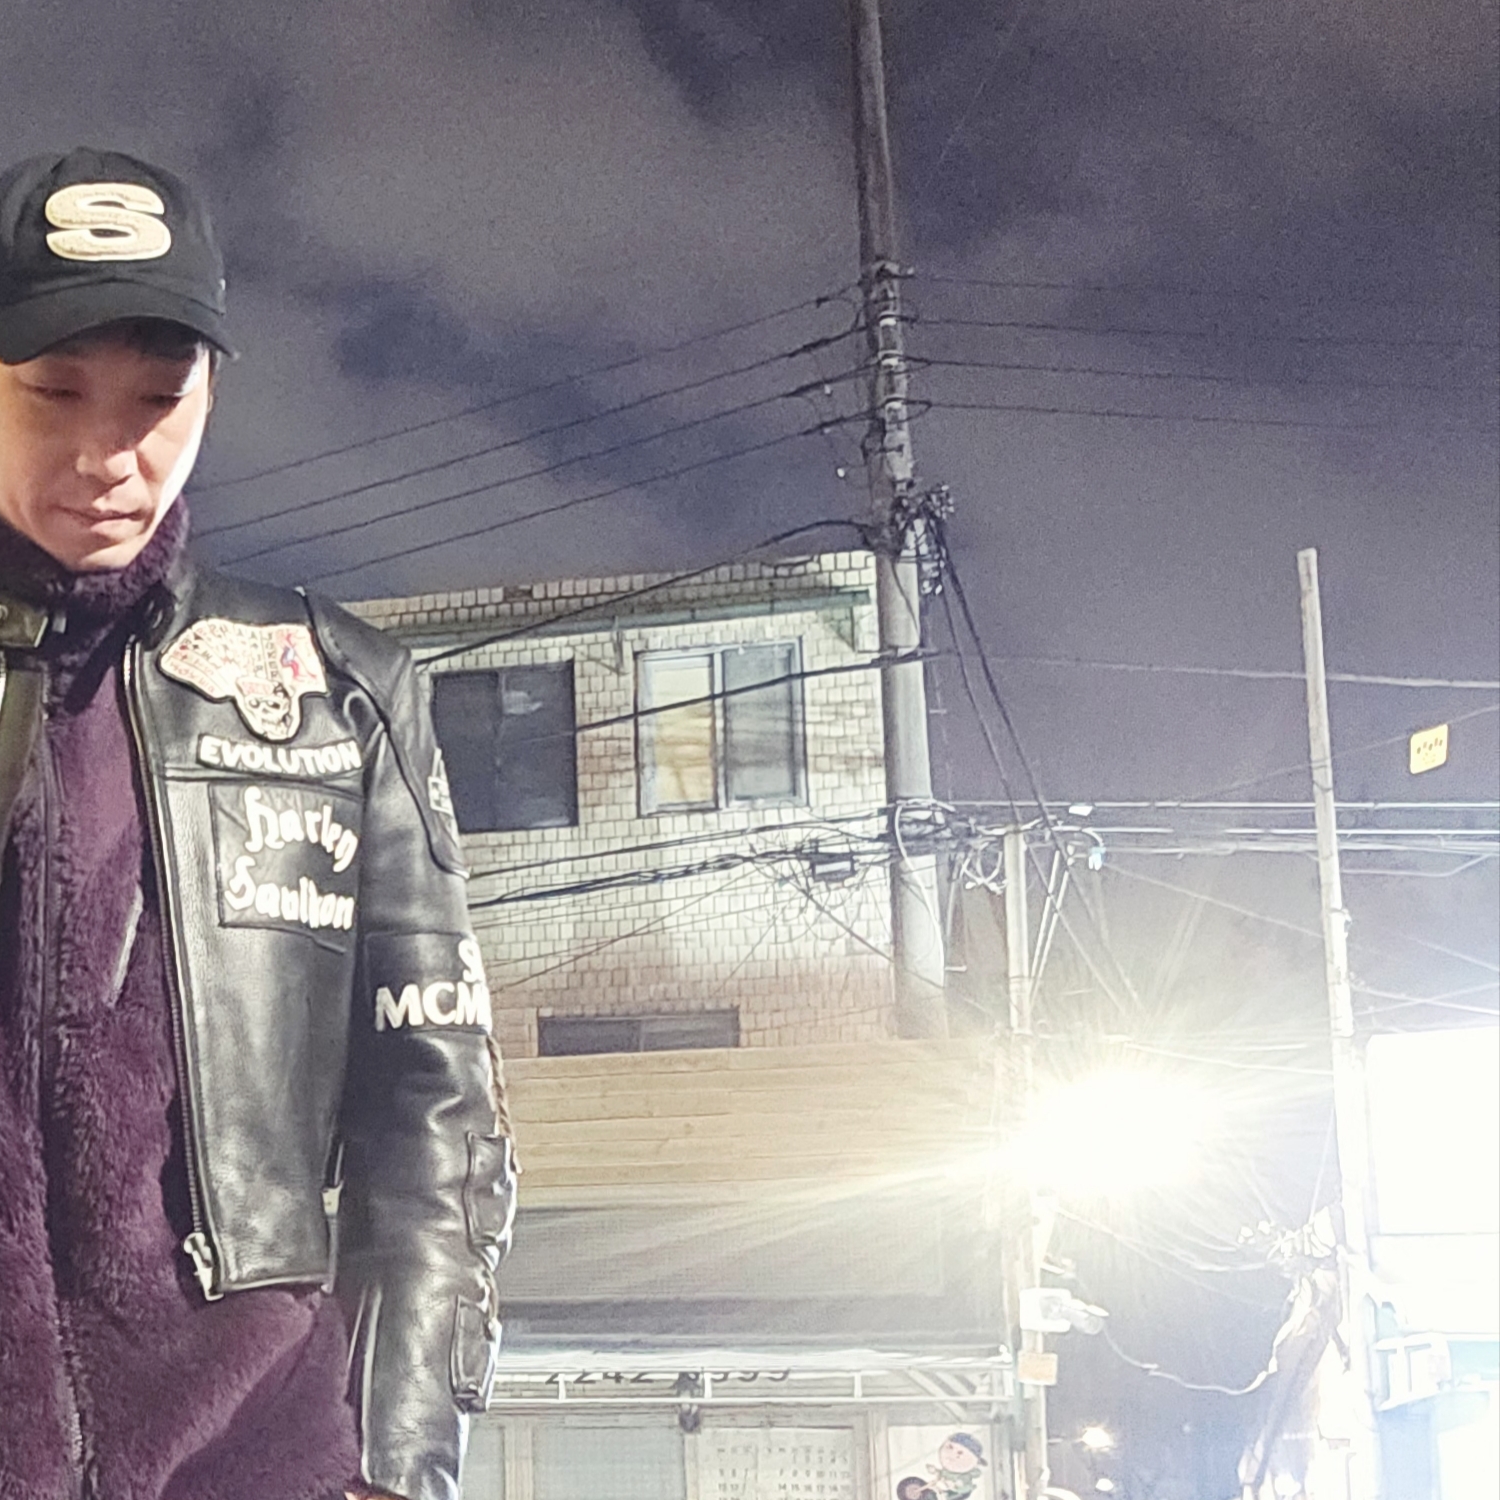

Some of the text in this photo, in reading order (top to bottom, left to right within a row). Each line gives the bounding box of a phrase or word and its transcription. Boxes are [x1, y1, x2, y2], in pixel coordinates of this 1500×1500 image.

[45, 182, 172, 261] S
[200, 734, 362, 775] EVOLUTION
[244, 785, 358, 873] Harley
